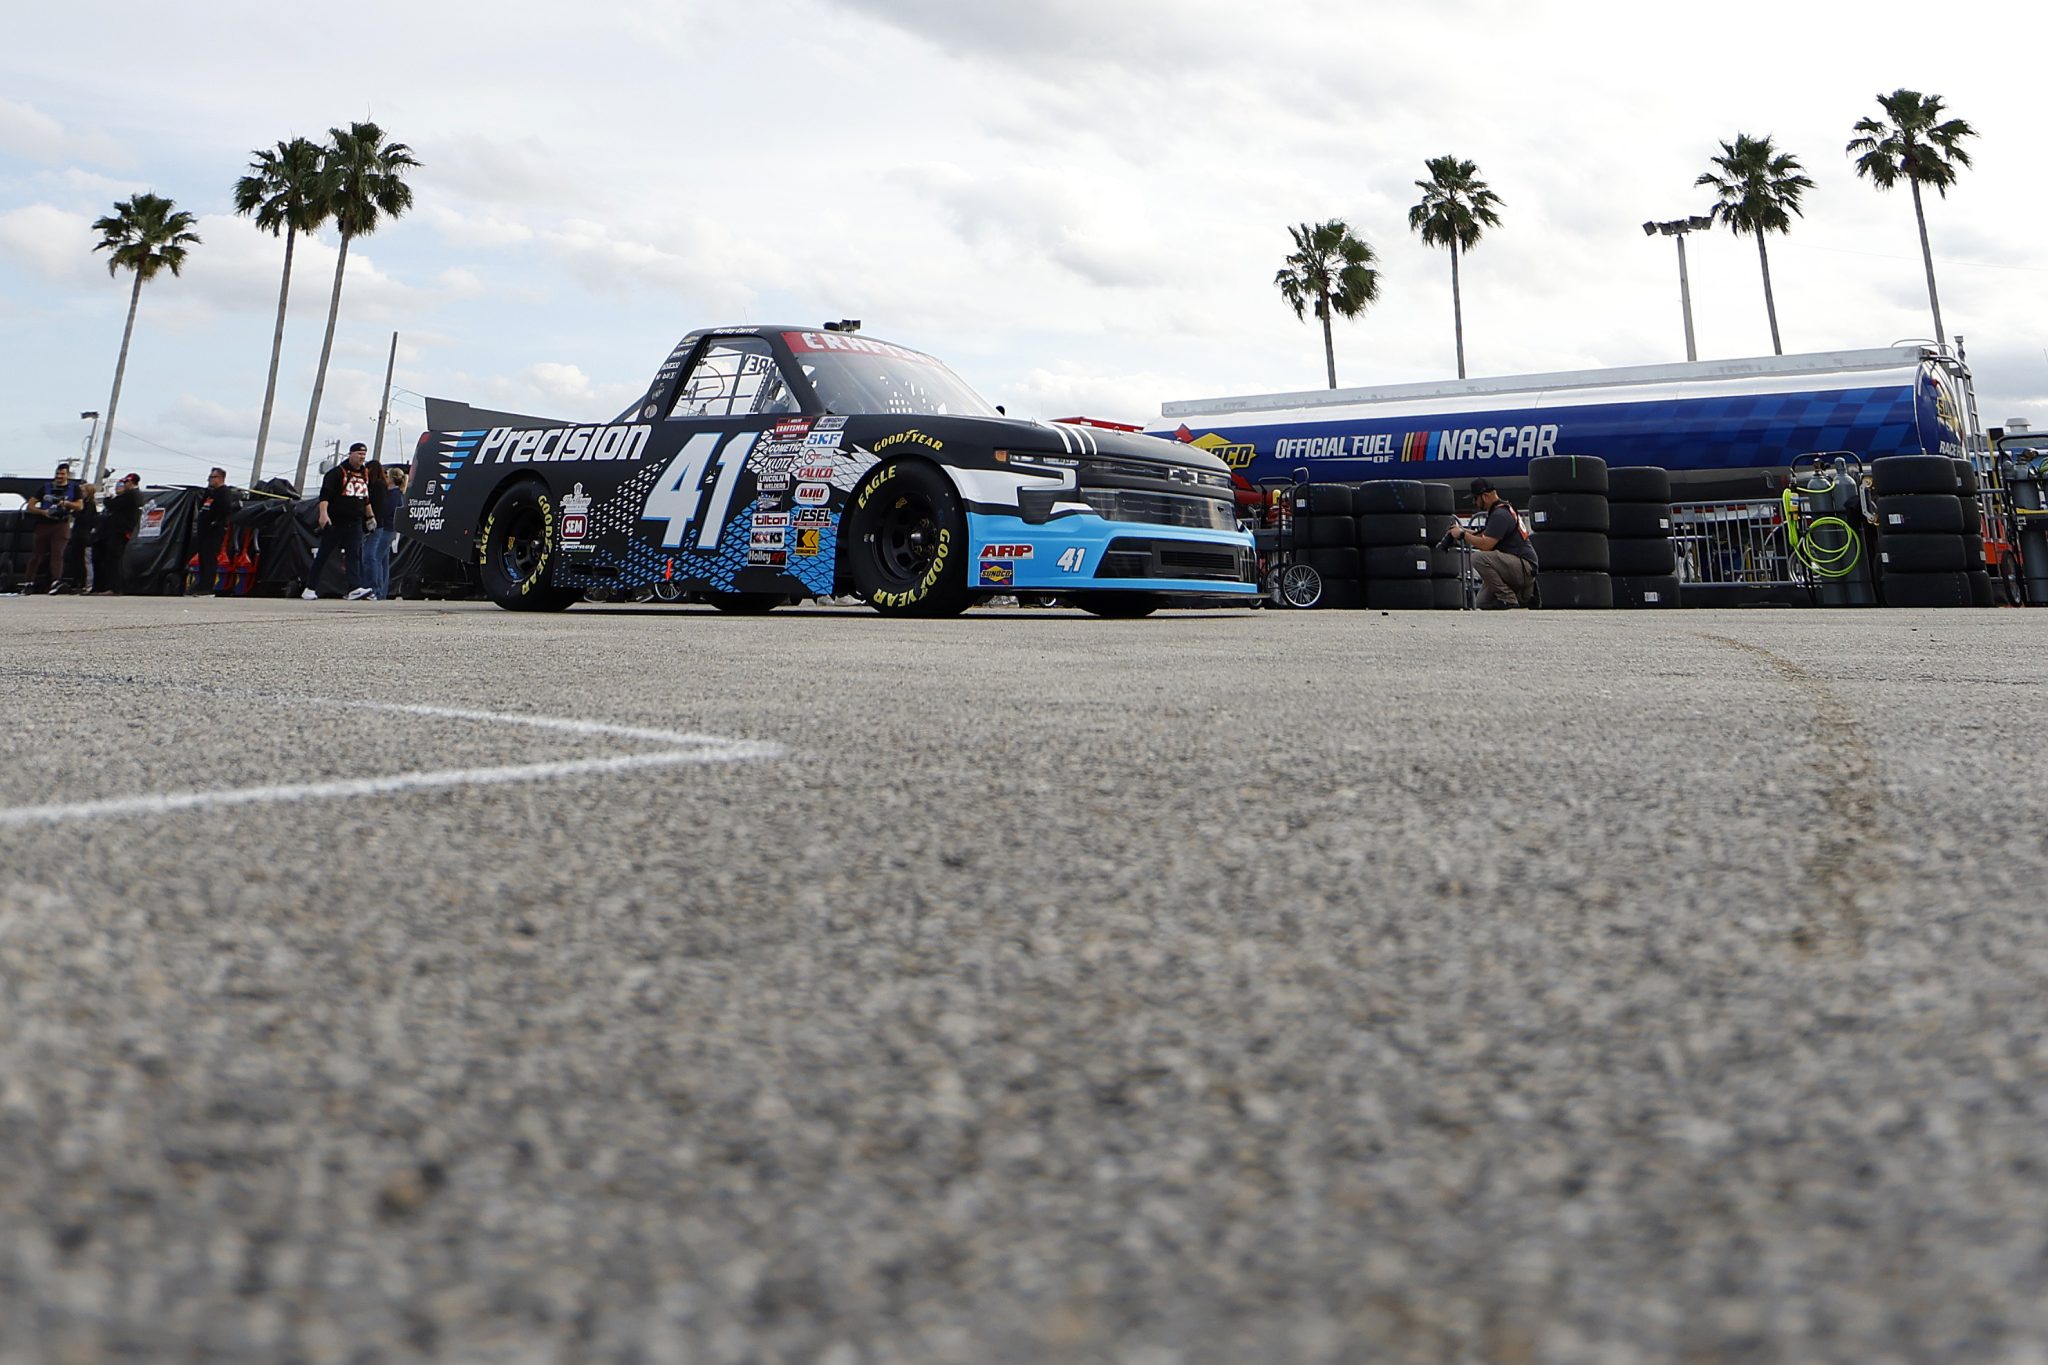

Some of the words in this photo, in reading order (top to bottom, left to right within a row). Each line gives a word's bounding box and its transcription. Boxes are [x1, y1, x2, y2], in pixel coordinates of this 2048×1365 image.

[474, 424, 651, 464] Precision
[768, 442, 801, 453] COMETIC
[807, 434, 841, 444] SKF
[874, 430, 943, 451] GOODYEAR
[1275, 436, 1348, 459] OFFICIAL
[1351, 434, 1394, 455] FUEL
[1438, 424, 1558, 461] NASCAR
[1206, 446, 1252, 465] OCO
[1939, 441, 1956, 456] RACE
[766, 457, 793, 469] KLOTZ
[798, 467, 833, 478] CALICO
[641, 432, 759, 549] 41
[858, 465, 896, 509] EAGLE
[409, 503, 443, 520] supplier
[754, 515, 787, 525] tilton
[794, 509, 830, 521] JESEL
[424, 518, 445, 533] year
[565, 520, 583, 533] SEM
[480, 513, 495, 564] EAGLE
[523, 495, 553, 595] GOODYEAR
[748, 550, 771, 564] Holley
[980, 545, 1033, 557] ARP
[873, 528, 950, 608] GOODYEAR
[1056, 547, 1086, 573] 41
